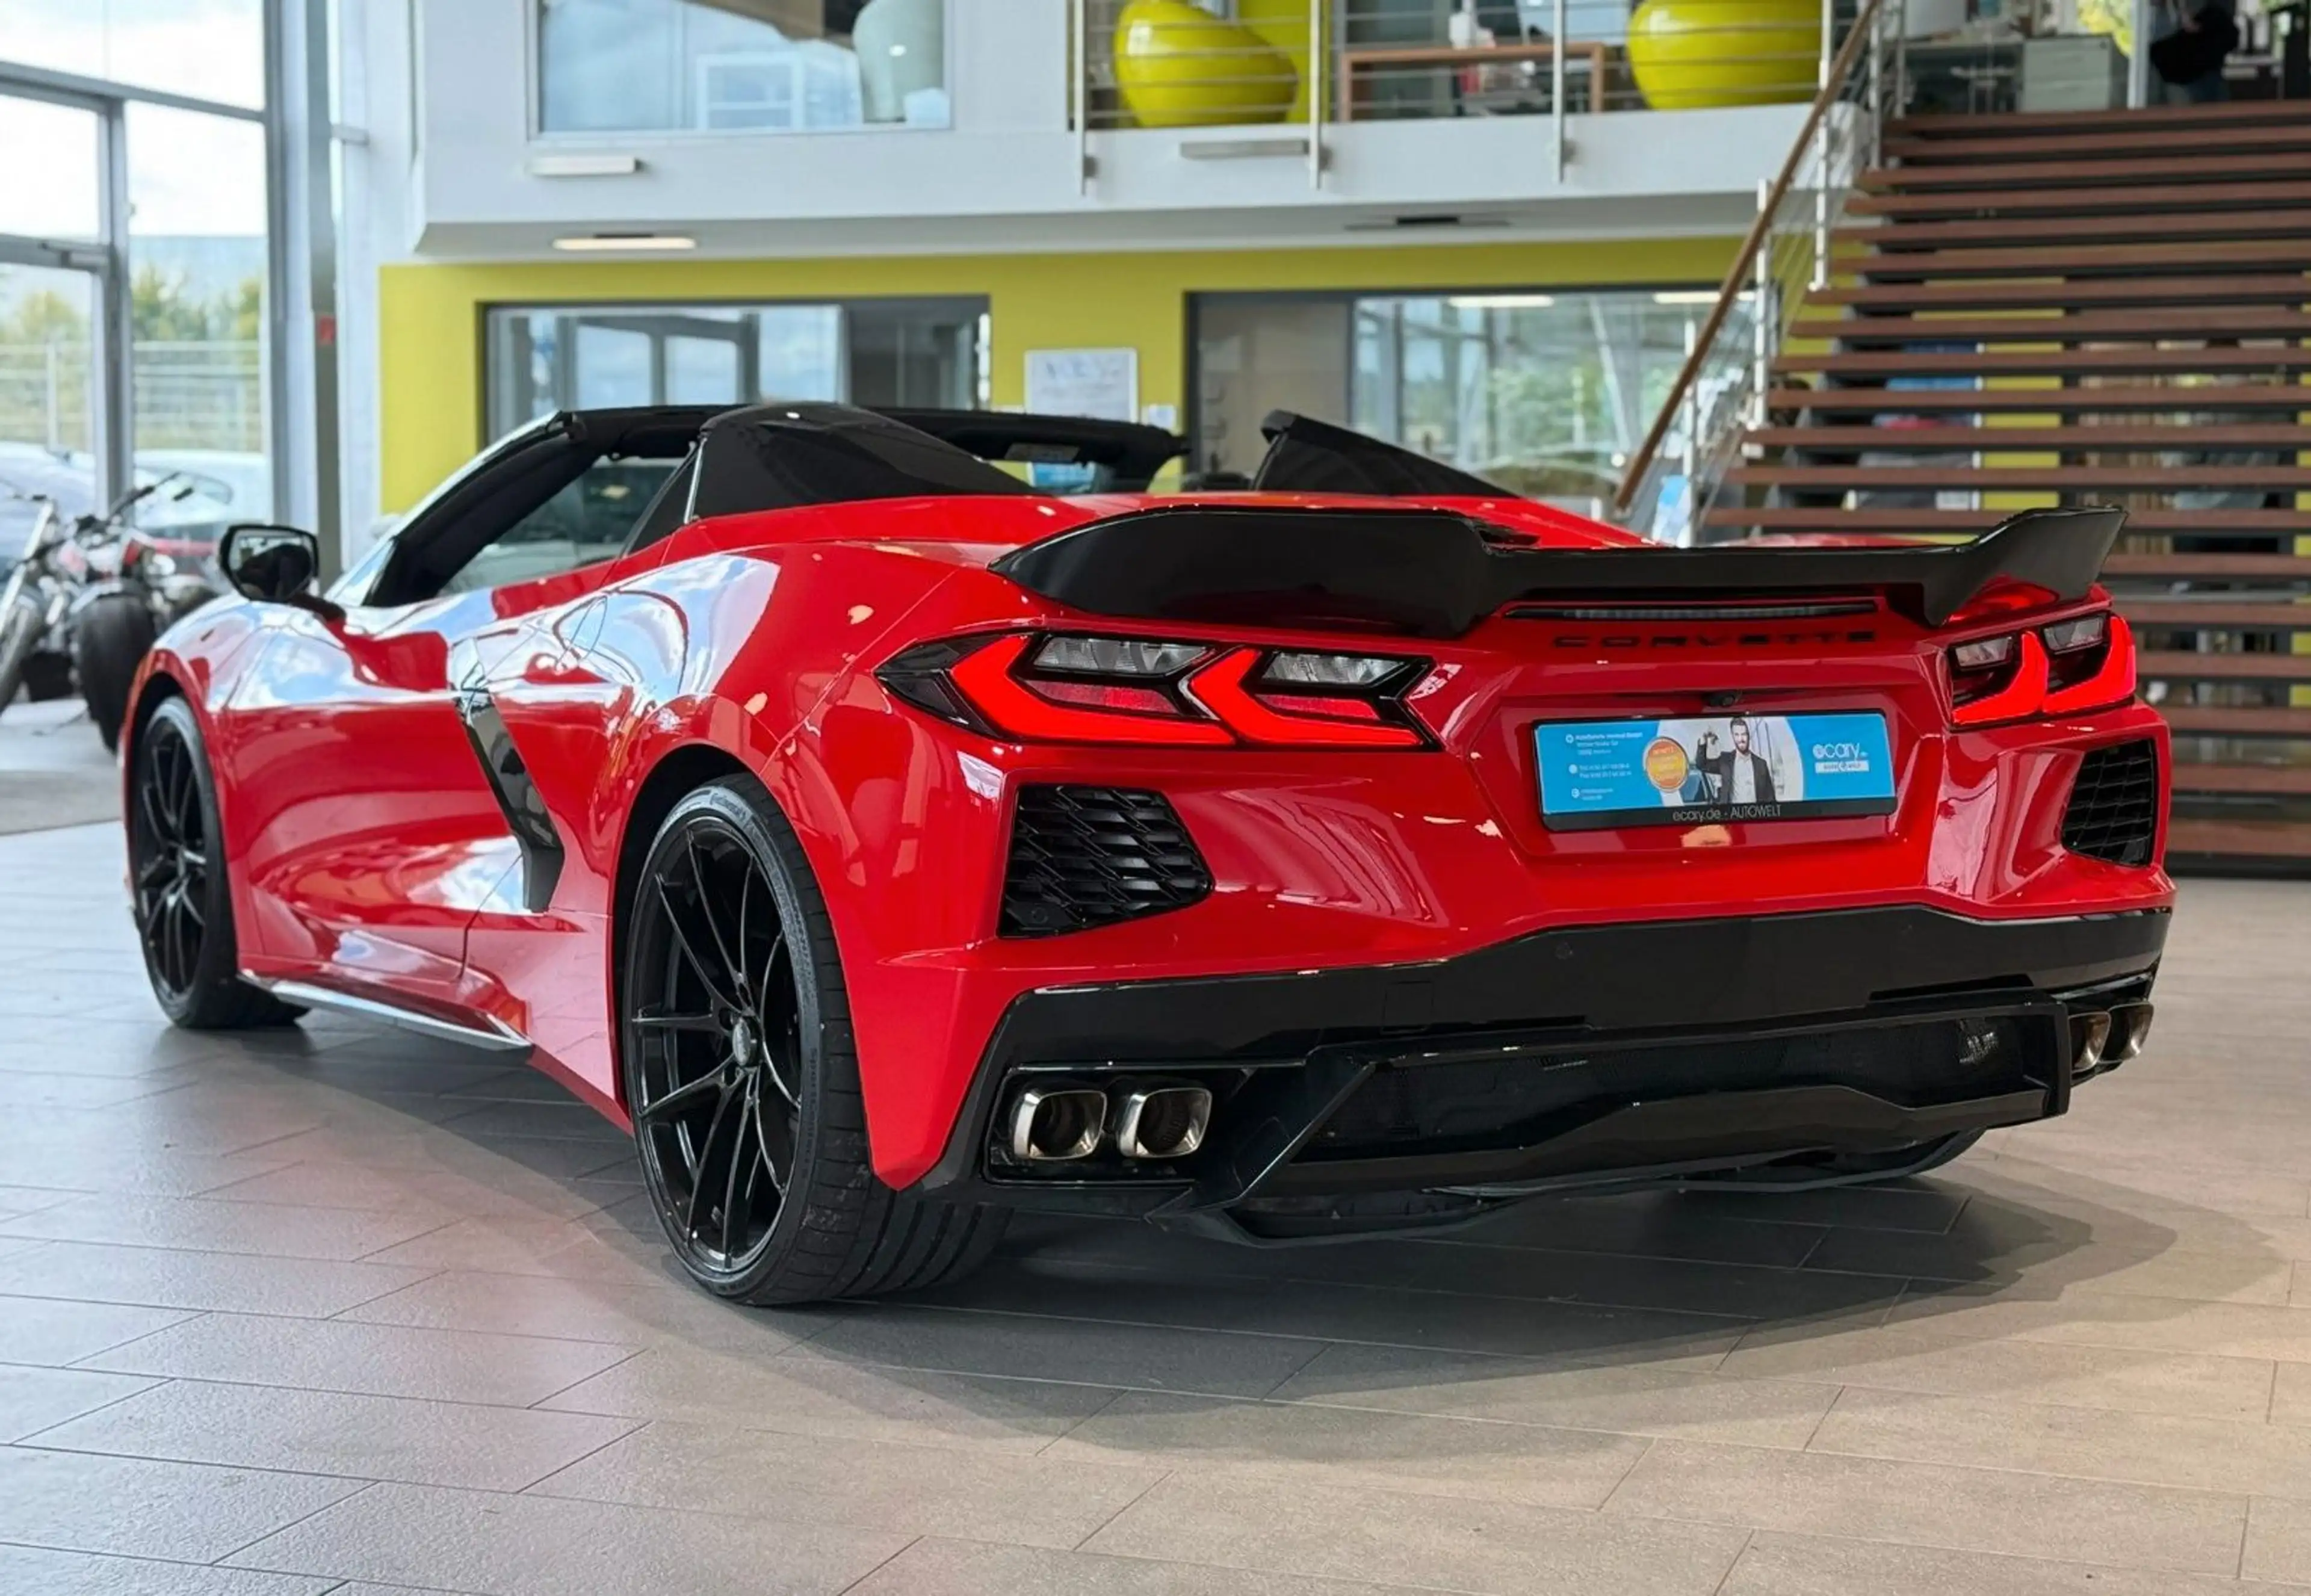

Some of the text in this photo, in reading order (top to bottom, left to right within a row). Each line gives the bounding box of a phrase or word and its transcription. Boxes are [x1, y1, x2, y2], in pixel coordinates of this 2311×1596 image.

[1553, 630, 1876, 648] CORVETTE
[1672, 808, 1721, 823] ecary.de
[1731, 805, 1781, 819] AUTOWELT
